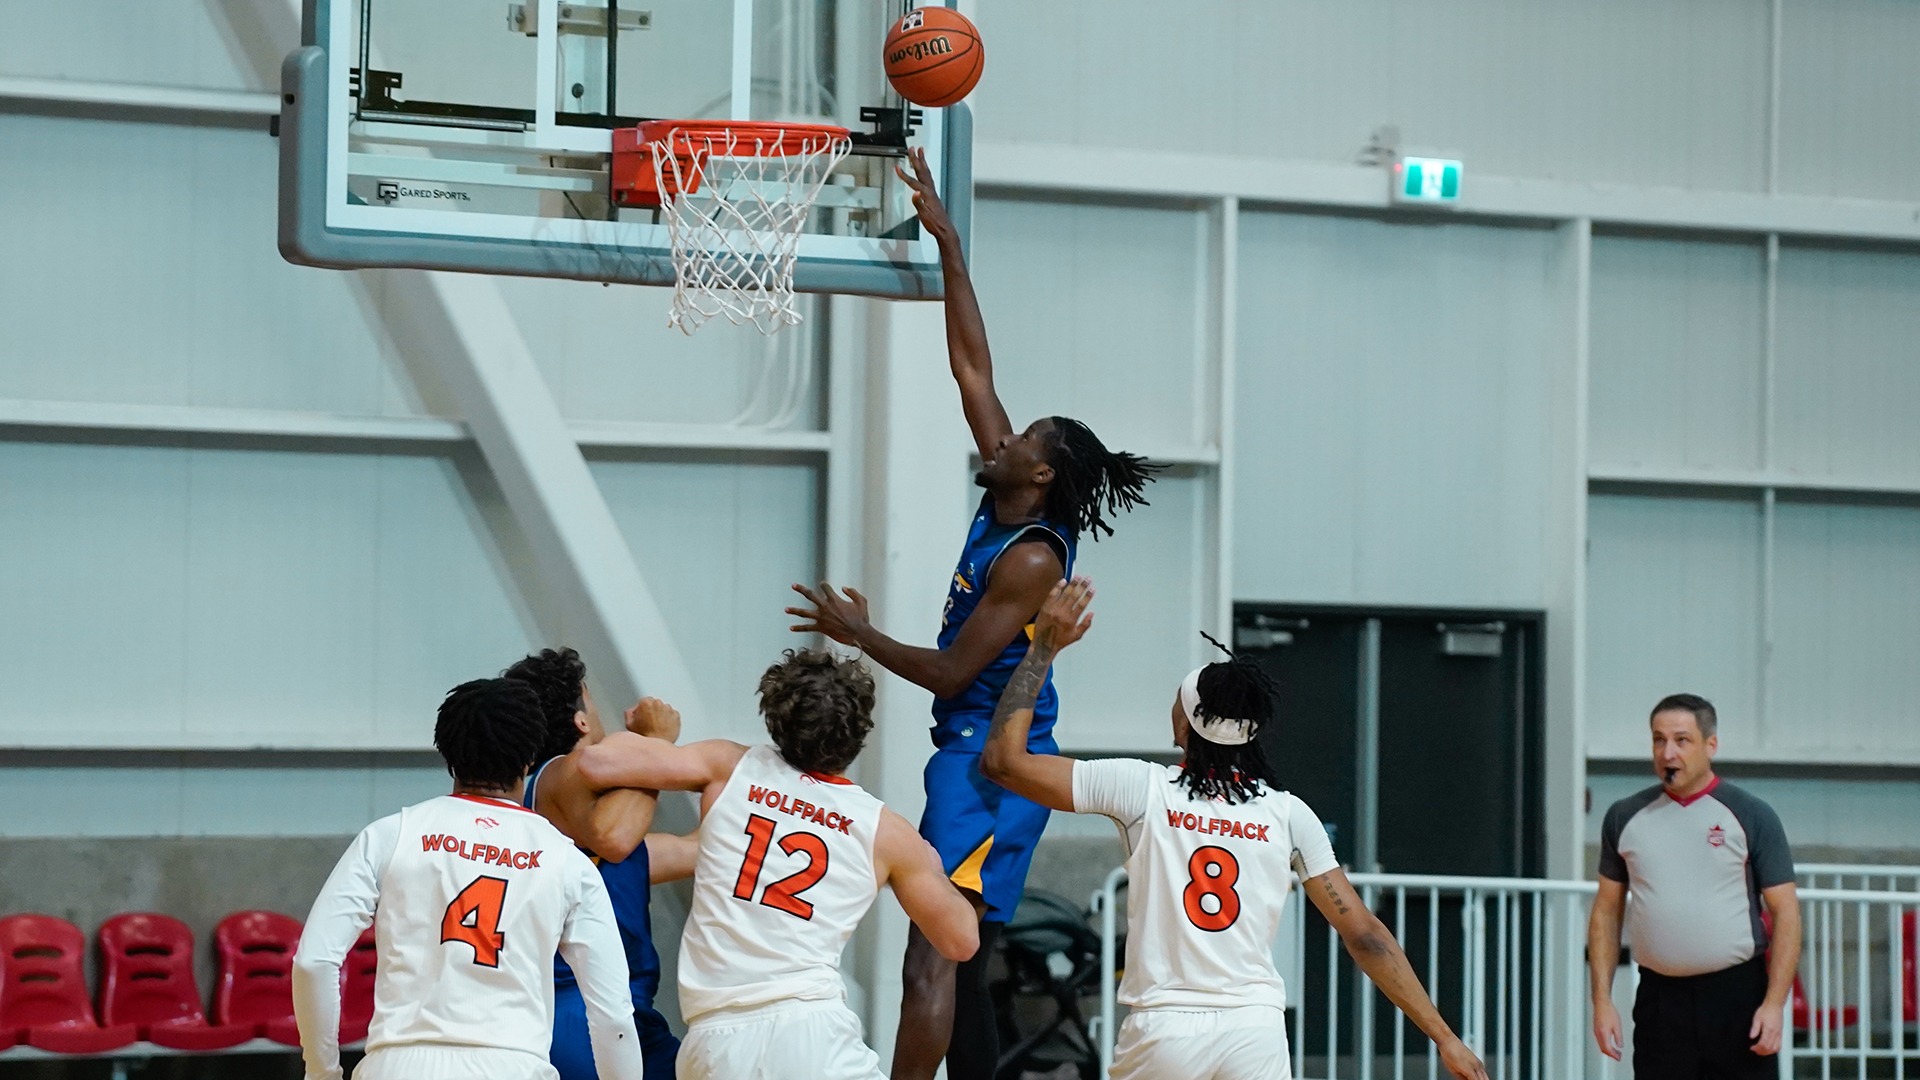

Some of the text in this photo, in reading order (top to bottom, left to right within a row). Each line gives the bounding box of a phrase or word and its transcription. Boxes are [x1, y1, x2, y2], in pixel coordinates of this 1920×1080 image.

[890, 35, 953, 64] Wilson
[748, 785, 854, 835] WOLFPACK
[1167, 809, 1270, 842] WOLFPACK
[422, 834, 543, 869] WOLFPACK
[733, 813, 829, 921] 12
[1183, 845, 1241, 932] 8
[440, 875, 509, 968] 4
